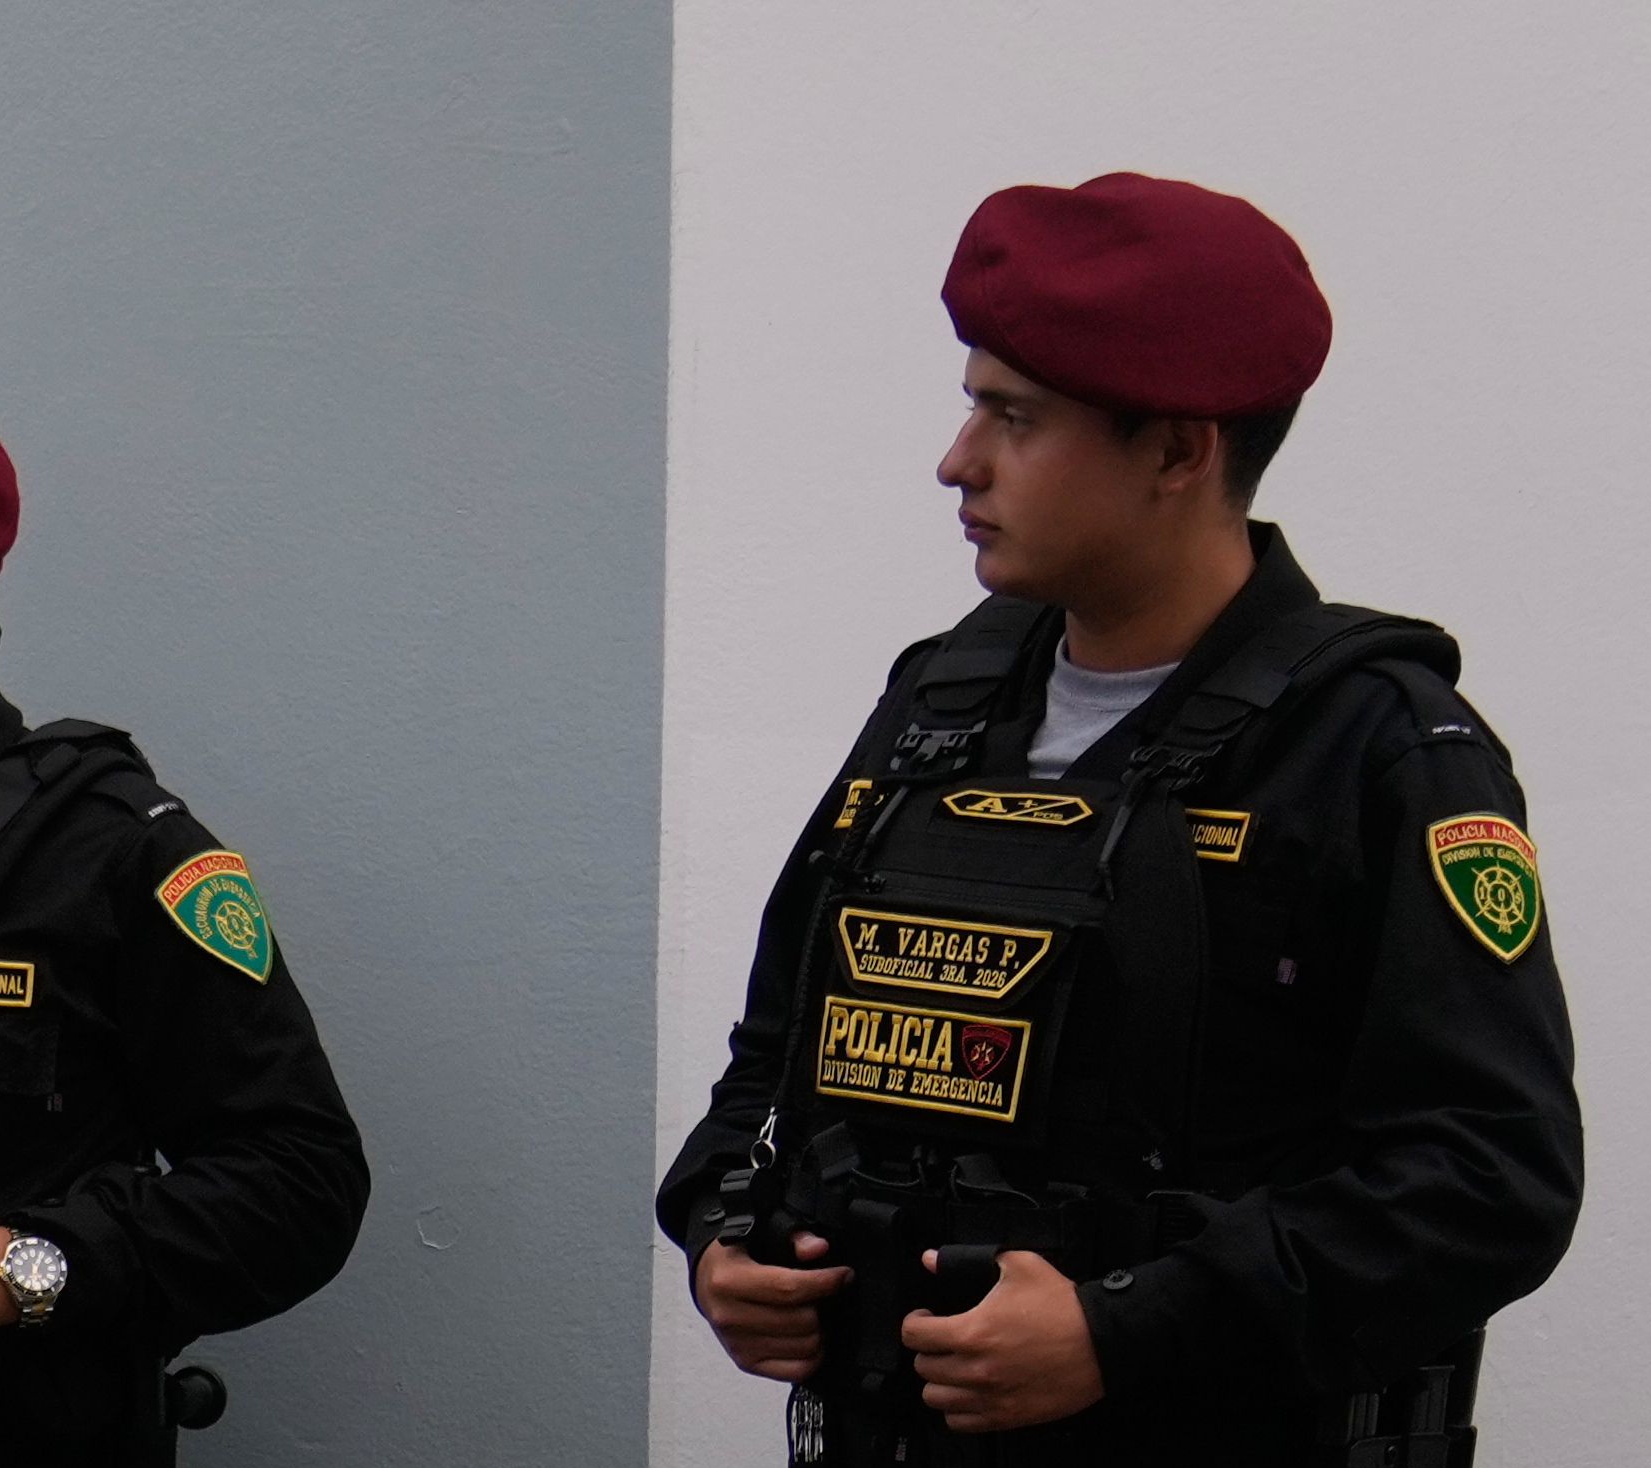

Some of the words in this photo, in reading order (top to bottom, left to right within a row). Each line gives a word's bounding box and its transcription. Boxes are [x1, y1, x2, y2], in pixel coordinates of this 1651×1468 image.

[966, 797, 1008, 813] A
[1191, 823, 1239, 847] CIONAL
[1436, 823, 1488, 845] POLICIA
[164, 867, 201, 901] POLICIA
[200, 855, 247, 878] NACIONAL
[855, 923, 880, 951] M.
[898, 928, 990, 962] VARGAS
[1001, 939, 1021, 969] P.
[859, 954, 933, 979] SUBOFICIAL
[972, 968, 1007, 989] 2026
[825, 1006, 953, 1071] POLICIA
[822, 1060, 880, 1088] DIVISION
[886, 1069, 905, 1091] DE
[910, 1072, 1003, 1106] EMERGENCIA
